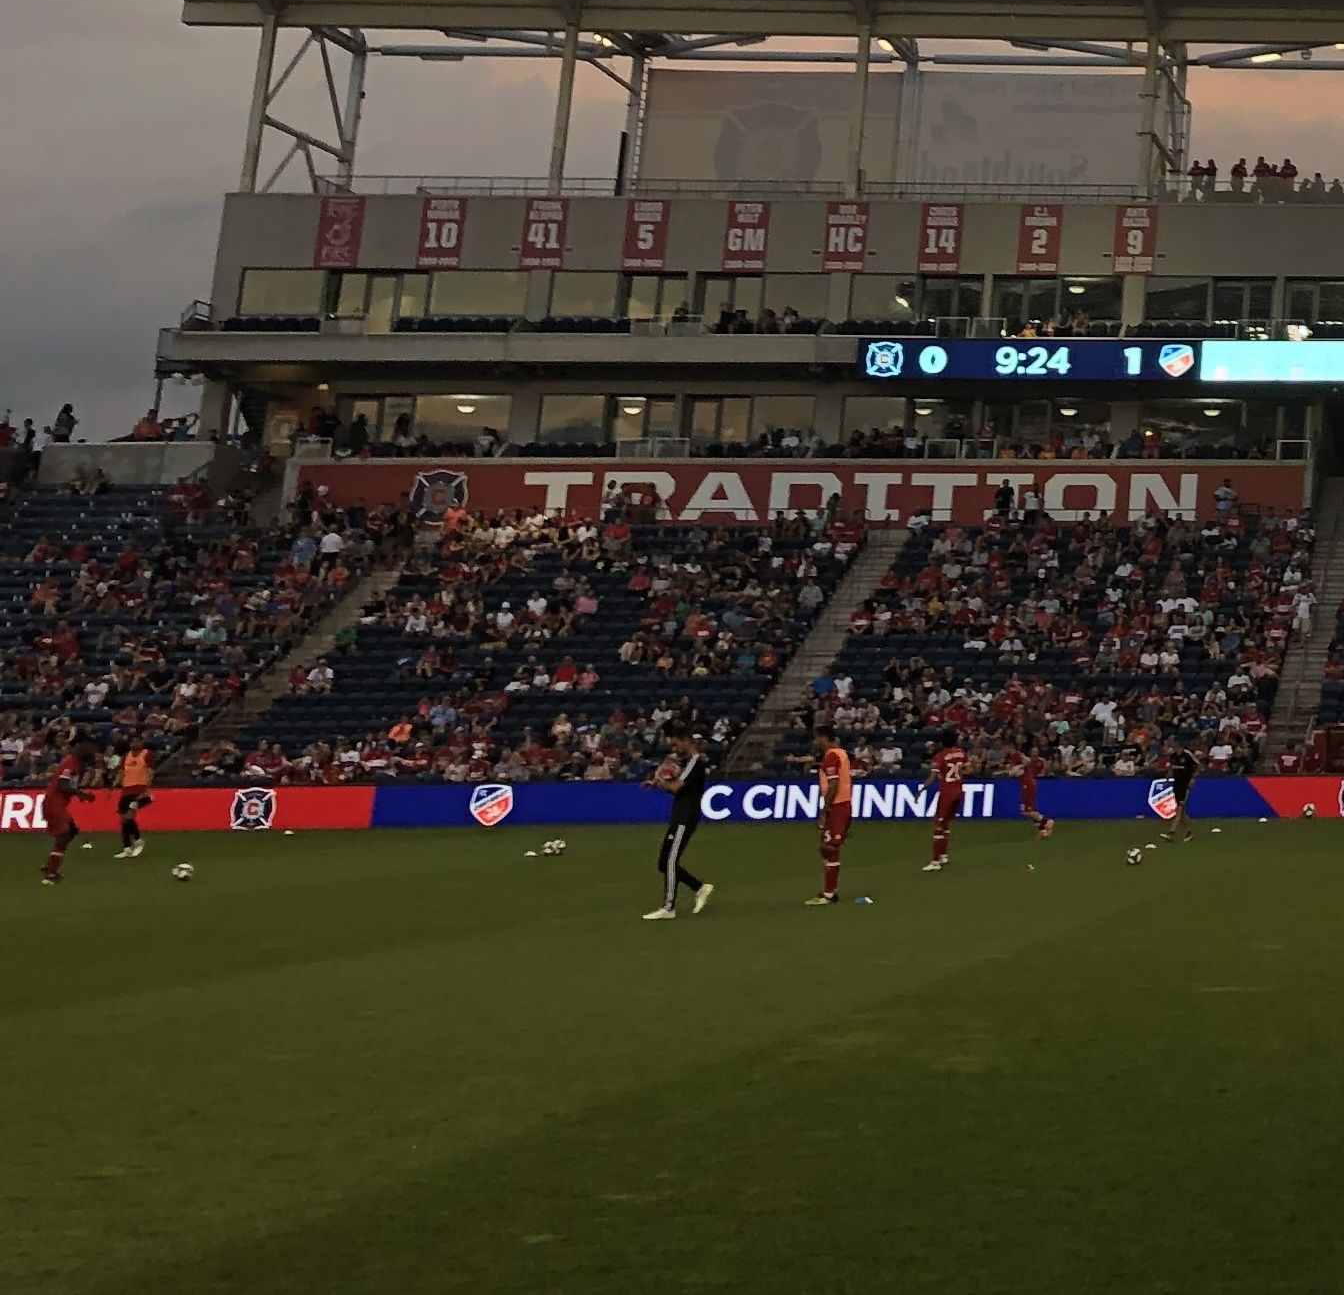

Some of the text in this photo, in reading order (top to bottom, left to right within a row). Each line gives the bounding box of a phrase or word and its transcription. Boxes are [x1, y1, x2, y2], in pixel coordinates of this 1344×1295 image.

[424, 222, 458, 248] 10
[527, 222, 561, 249] 41
[636, 223, 655, 250] 5
[727, 227, 766, 251] GM
[828, 226, 865, 252] HC
[924, 228, 957, 254] 14
[1031, 228, 1048, 254] 2
[1126, 229, 1144, 254] 9
[919, 345, 1142, 375] 0 9:24 1
[523, 471, 1199, 522] TRADITION
[742, 783, 995, 820] CININNTI
